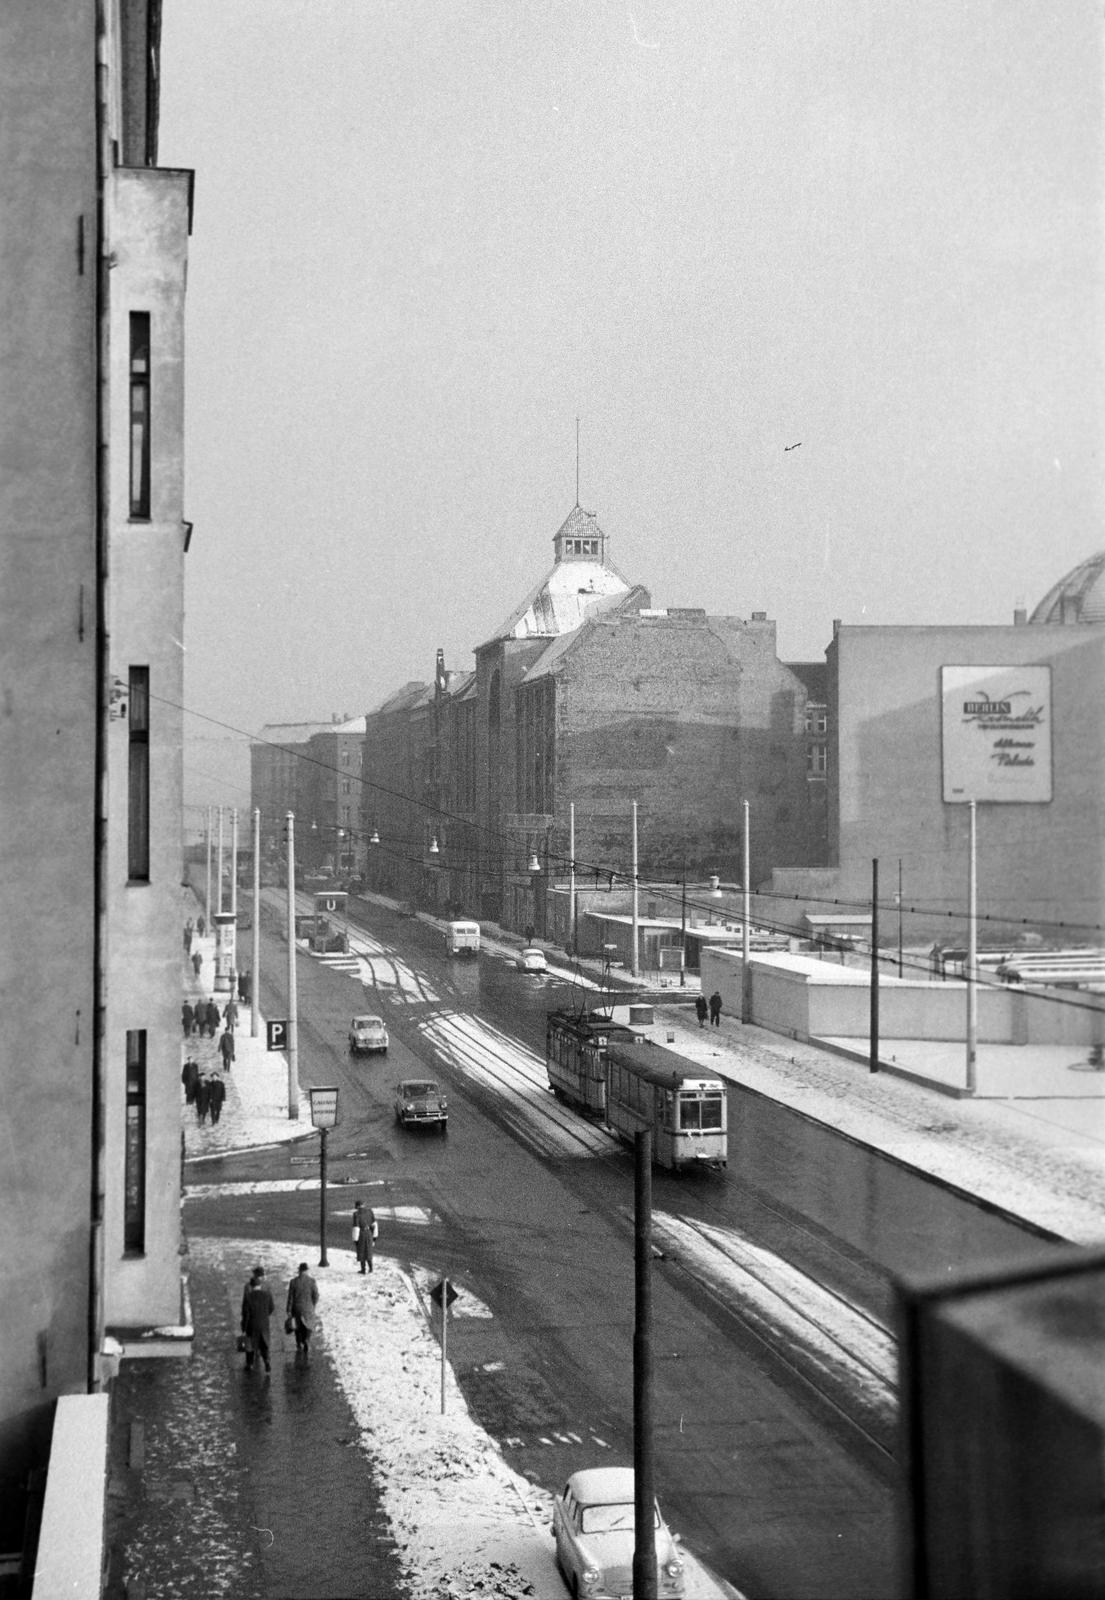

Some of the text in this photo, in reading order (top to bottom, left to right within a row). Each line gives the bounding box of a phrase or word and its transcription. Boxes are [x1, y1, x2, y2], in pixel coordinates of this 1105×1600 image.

[966, 702, 1008, 713] BERLIN
[326, 899, 336, 911] U
[272, 1023, 283, 1043] P
